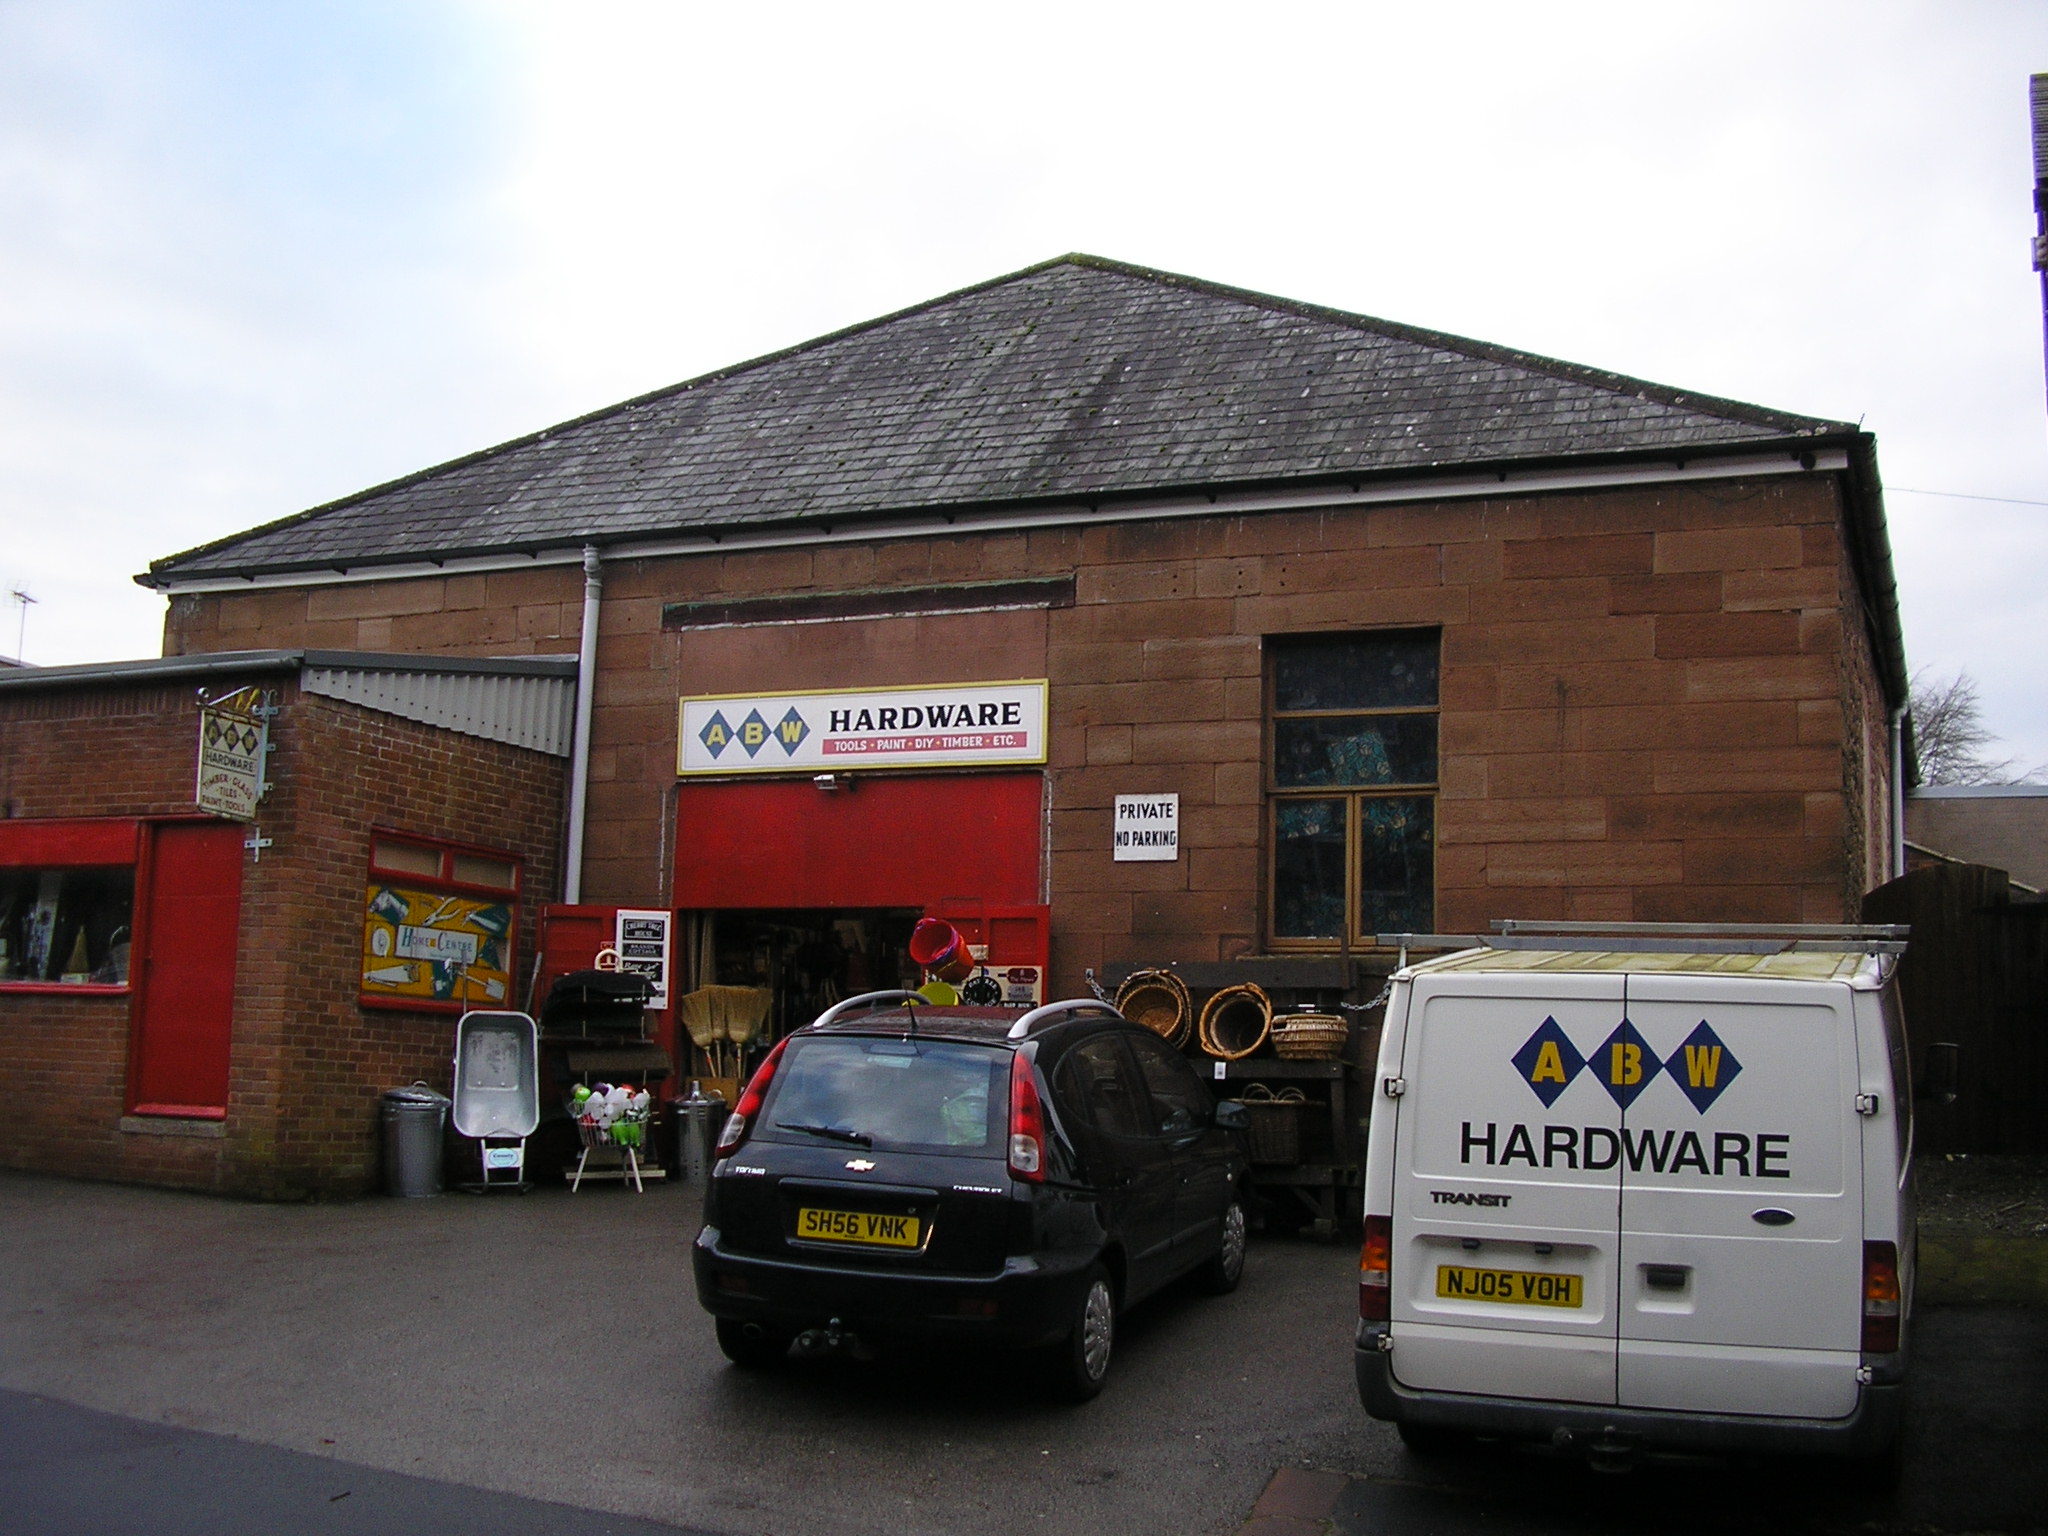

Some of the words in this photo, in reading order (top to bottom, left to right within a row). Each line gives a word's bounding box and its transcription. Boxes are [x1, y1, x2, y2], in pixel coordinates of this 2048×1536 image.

[829, 702, 1022, 733] HARDWARE
[834, 740, 867, 752] TOOLS
[877, 738, 907, 750] PAINT
[915, 738, 934, 748] DIY
[942, 736, 984, 748] TIMBER
[205, 750, 254, 772] HARDWARE
[1120, 803, 1173, 819] PRIVATE
[1116, 831, 1129, 847] NO
[1132, 830, 1176, 847] PARKING
[1460, 1121, 1792, 1178] HARDWARE
[1430, 1191, 1512, 1208] TRANSIT
[806, 1210, 860, 1235] SH56
[867, 1215, 908, 1239] VNK
[1447, 1269, 1514, 1298] NJ05
[1522, 1274, 1571, 1302] VOH
